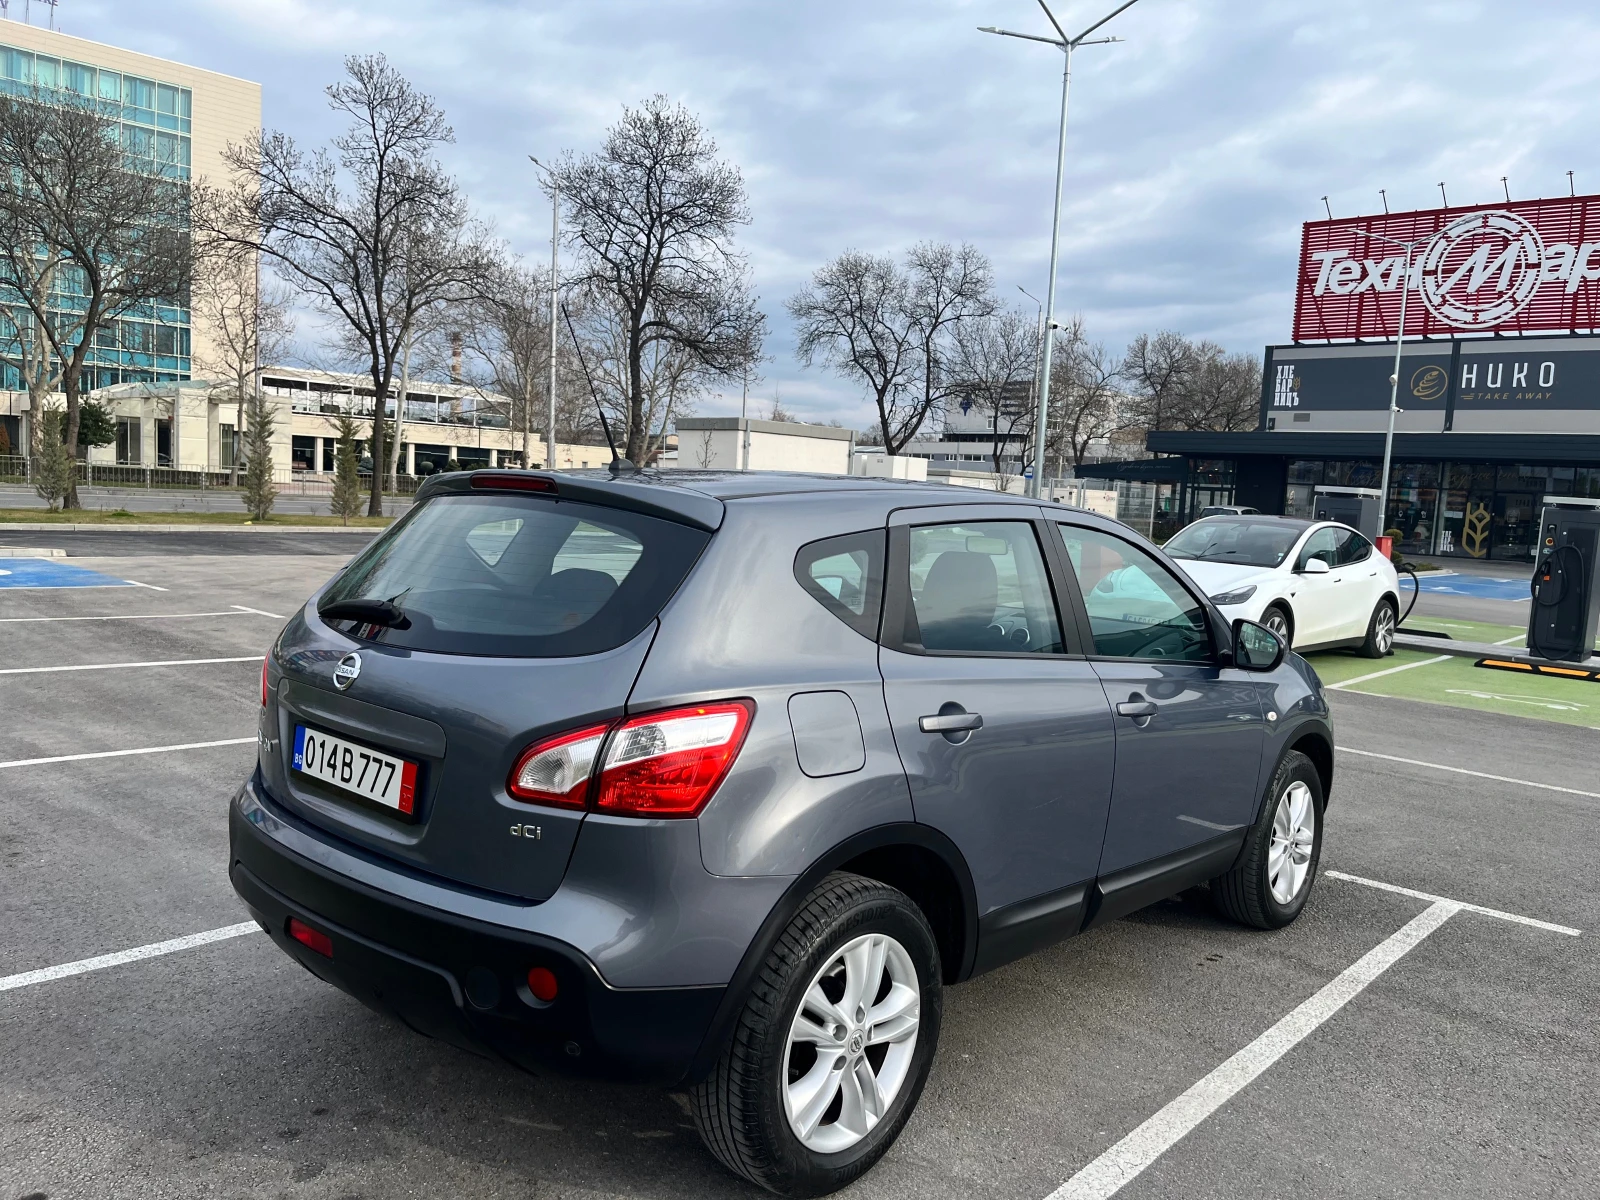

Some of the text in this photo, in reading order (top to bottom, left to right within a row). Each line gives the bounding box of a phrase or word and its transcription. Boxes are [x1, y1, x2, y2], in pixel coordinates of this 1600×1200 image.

[1276, 365, 1295, 379] ХЛЕ
[1274, 378, 1293, 393] БАР
[1273, 392, 1300, 408] НИЦЪ
[1477, 392, 1553, 400] TAKE AWAY
[294, 753, 303, 765] BG
[305, 735, 397, 798] 014B777
